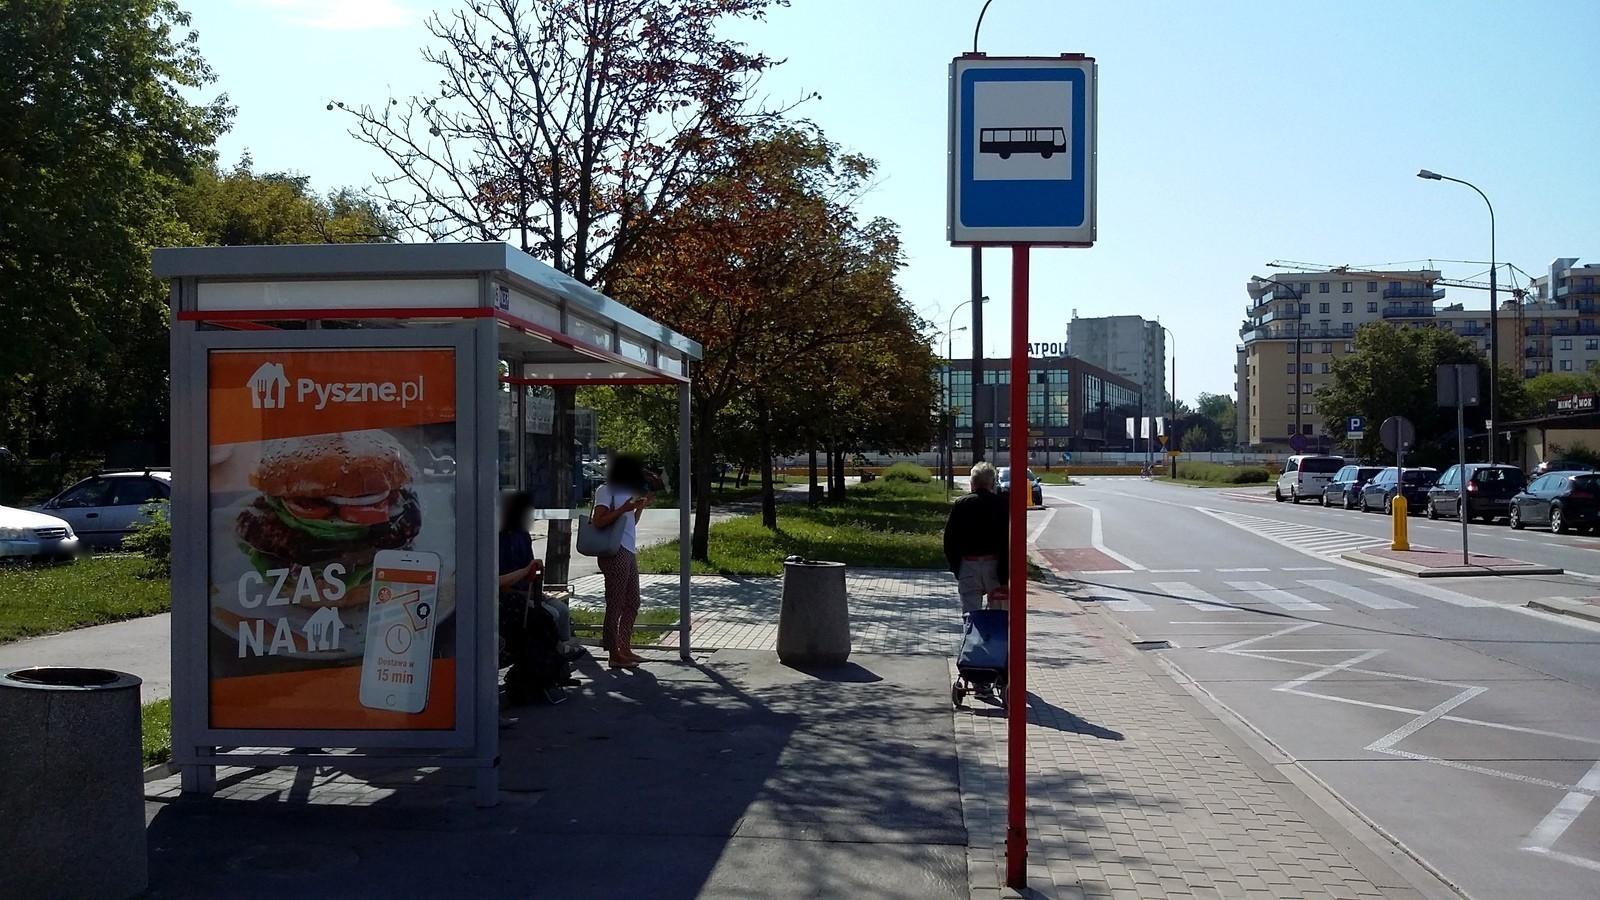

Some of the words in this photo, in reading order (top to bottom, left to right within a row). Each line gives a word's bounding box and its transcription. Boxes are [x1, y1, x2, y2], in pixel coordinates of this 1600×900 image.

[297, 375, 424, 410] Pyszne.pl
[1351, 418, 1360, 430] P
[238, 562, 346, 609] CZAS
[238, 617, 297, 658] NA
[377, 668, 389, 682] 15
[391, 670, 414, 684] min
